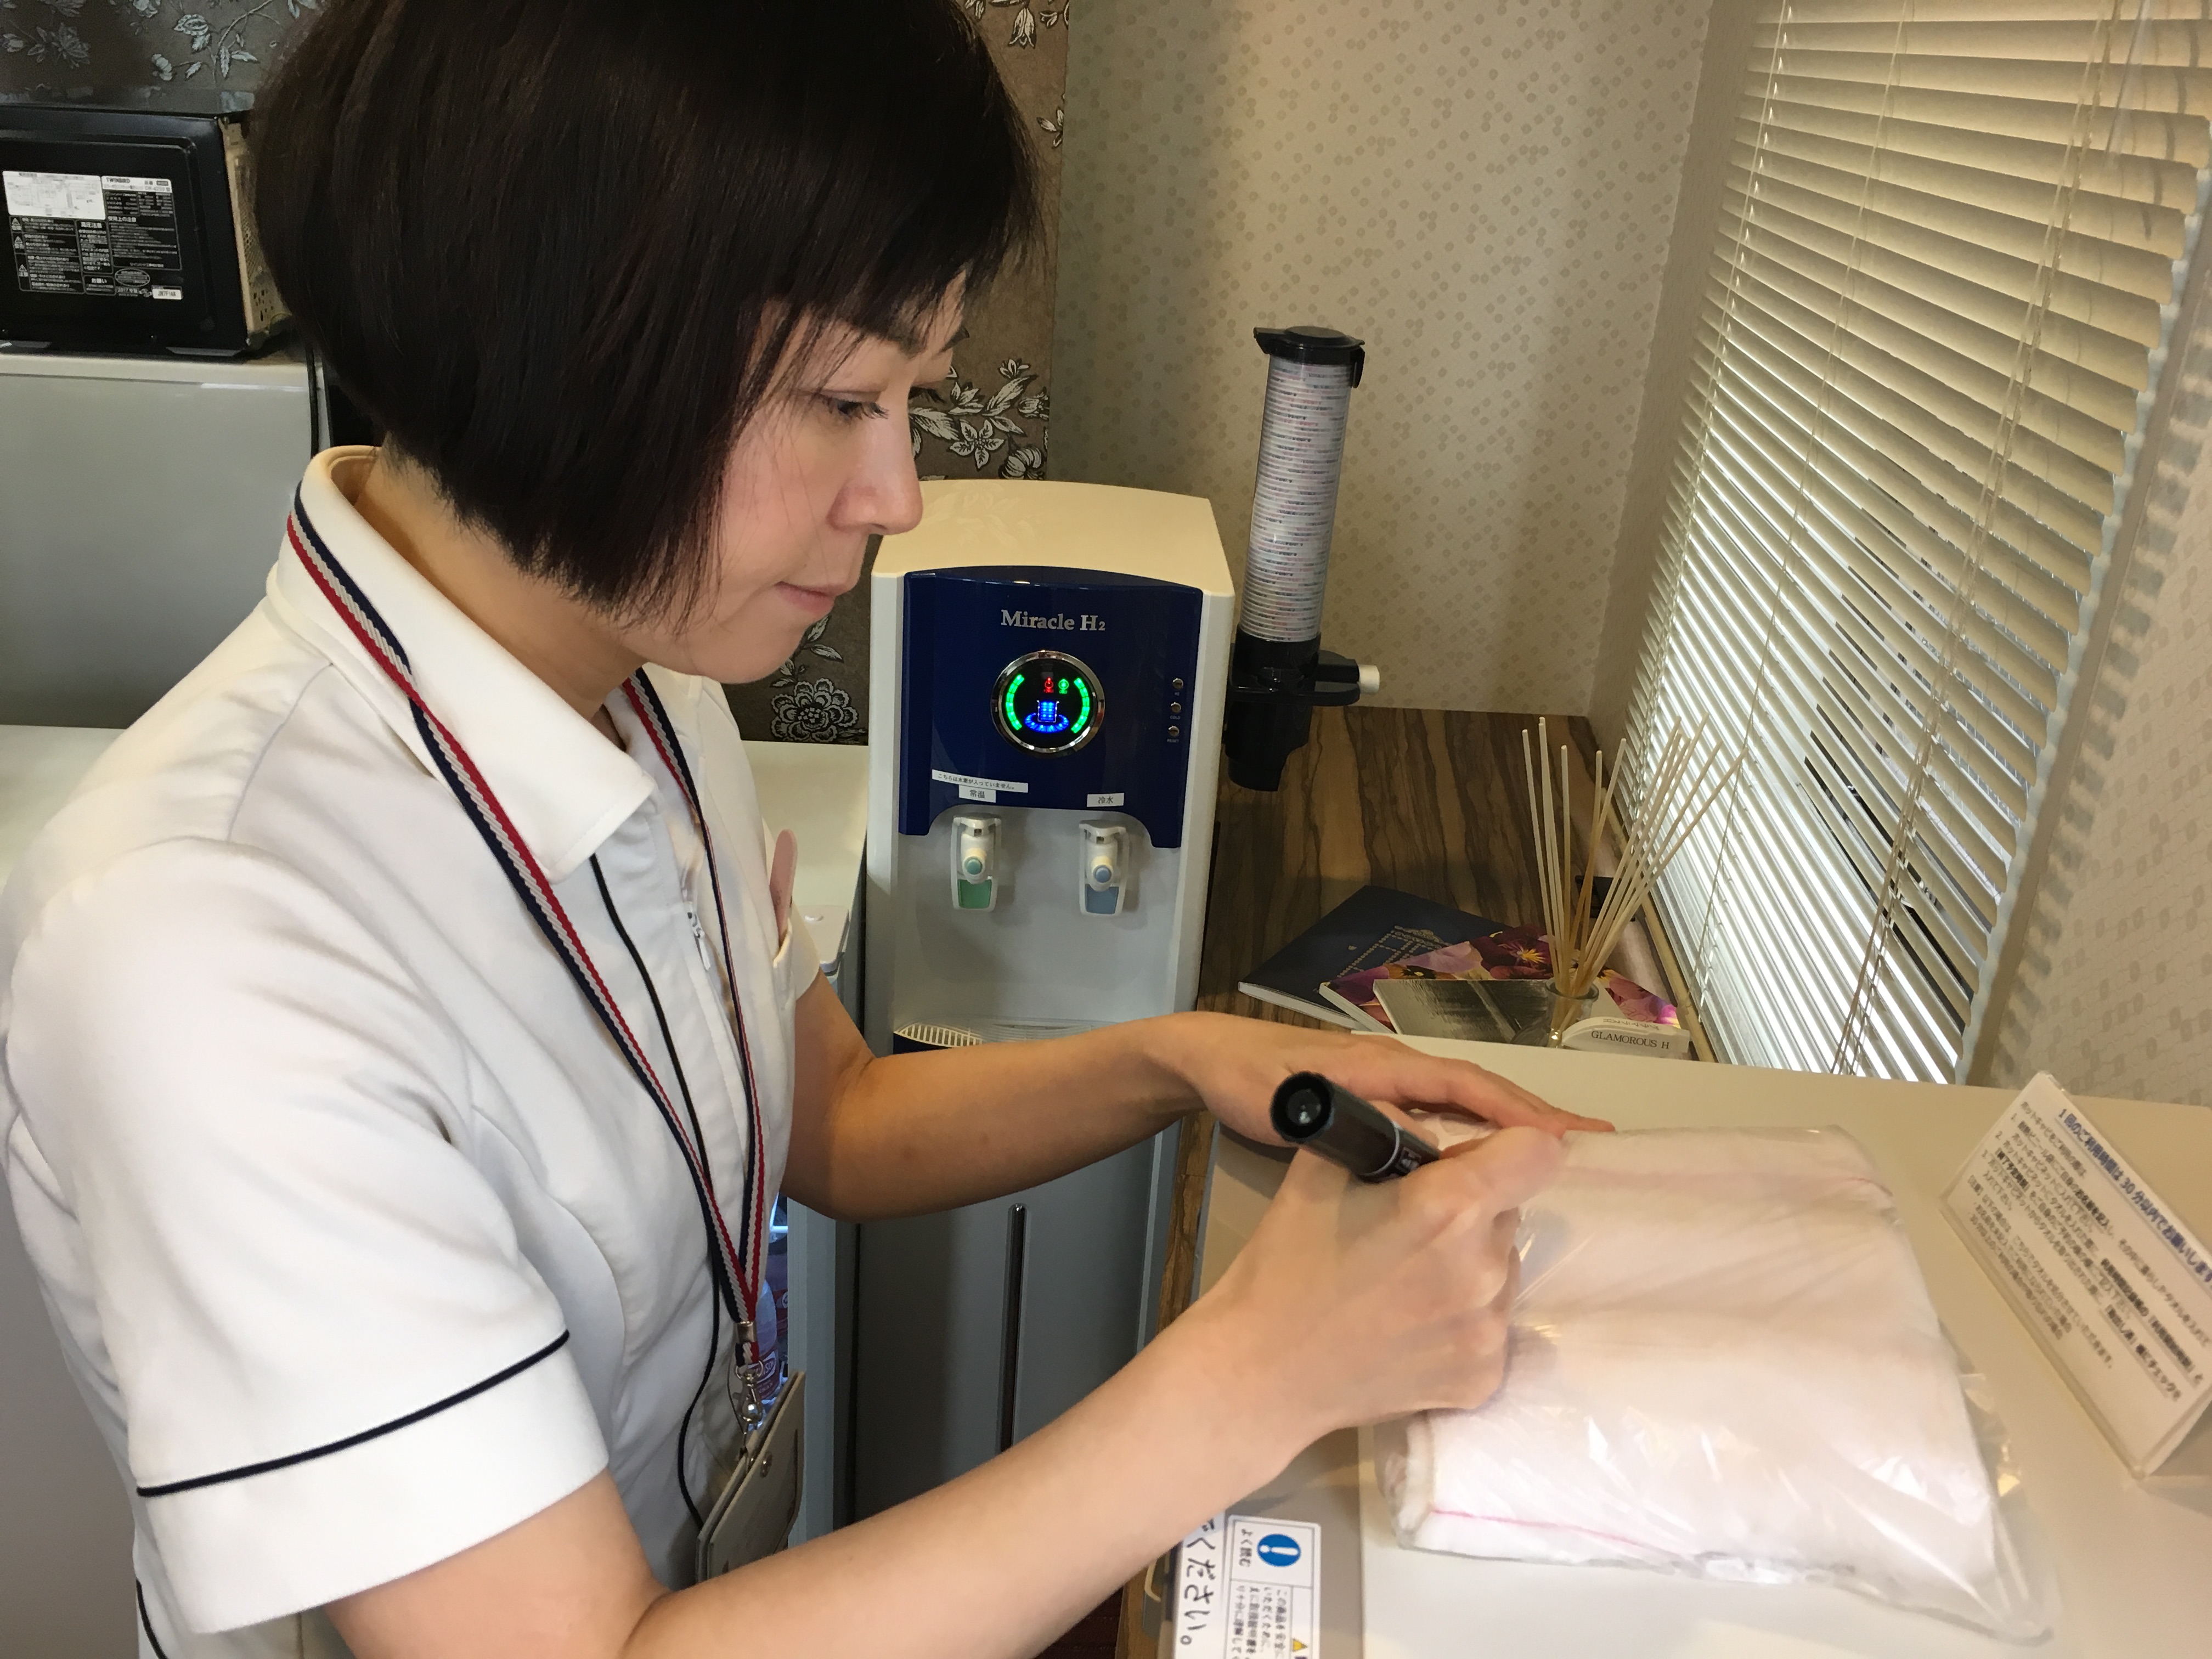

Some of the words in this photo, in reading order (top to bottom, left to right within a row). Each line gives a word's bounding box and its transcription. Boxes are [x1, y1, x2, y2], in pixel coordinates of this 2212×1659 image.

[1001, 609, 1075, 630] Miracle
[969, 789, 985, 799] 常温
[1098, 795, 1114, 804] 冷水
[1591, 1030, 1658, 1048] GLAMOROUS
[1661, 1041, 1670, 1049] H
[1239, 1528, 1254, 1567] よく読む
